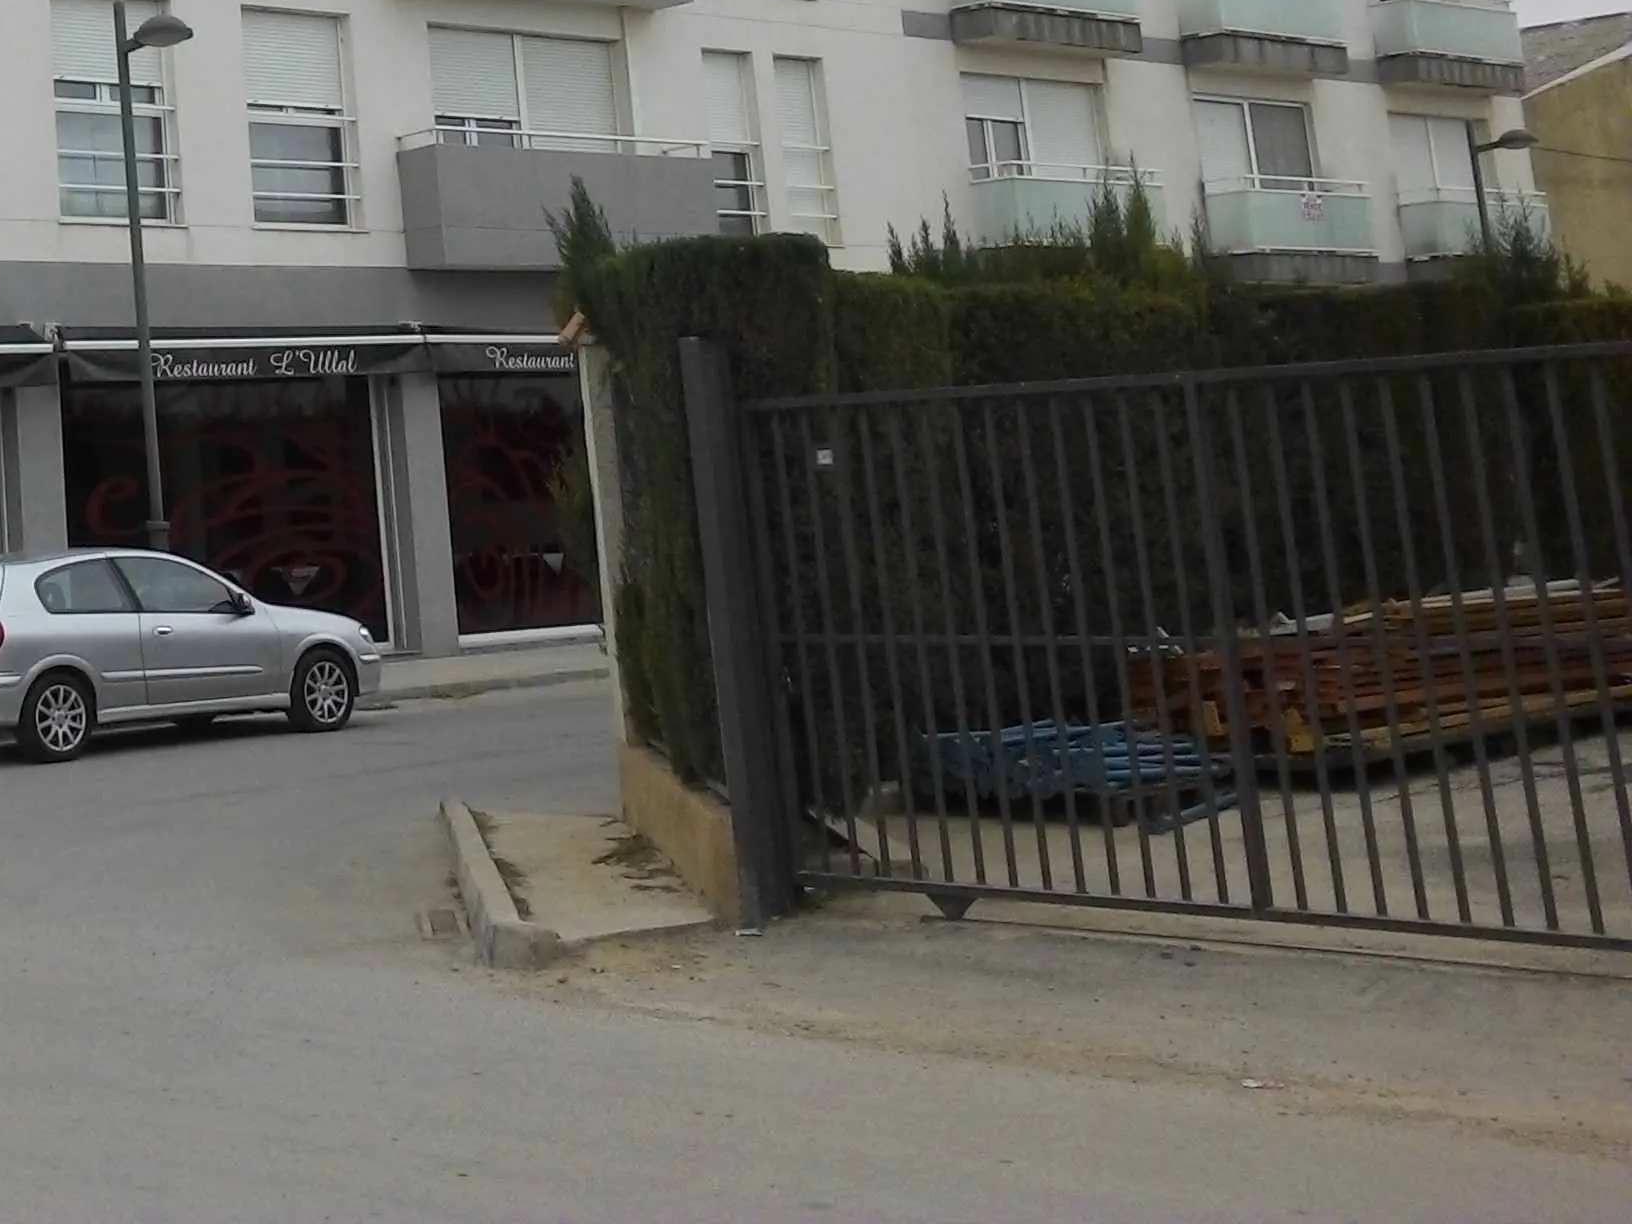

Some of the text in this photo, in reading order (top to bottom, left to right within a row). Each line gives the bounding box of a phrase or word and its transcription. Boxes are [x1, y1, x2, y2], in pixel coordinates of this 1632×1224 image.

[150, 349, 357, 378] Restaurant L'Ullal
[485, 345, 575, 369] Restaurant
